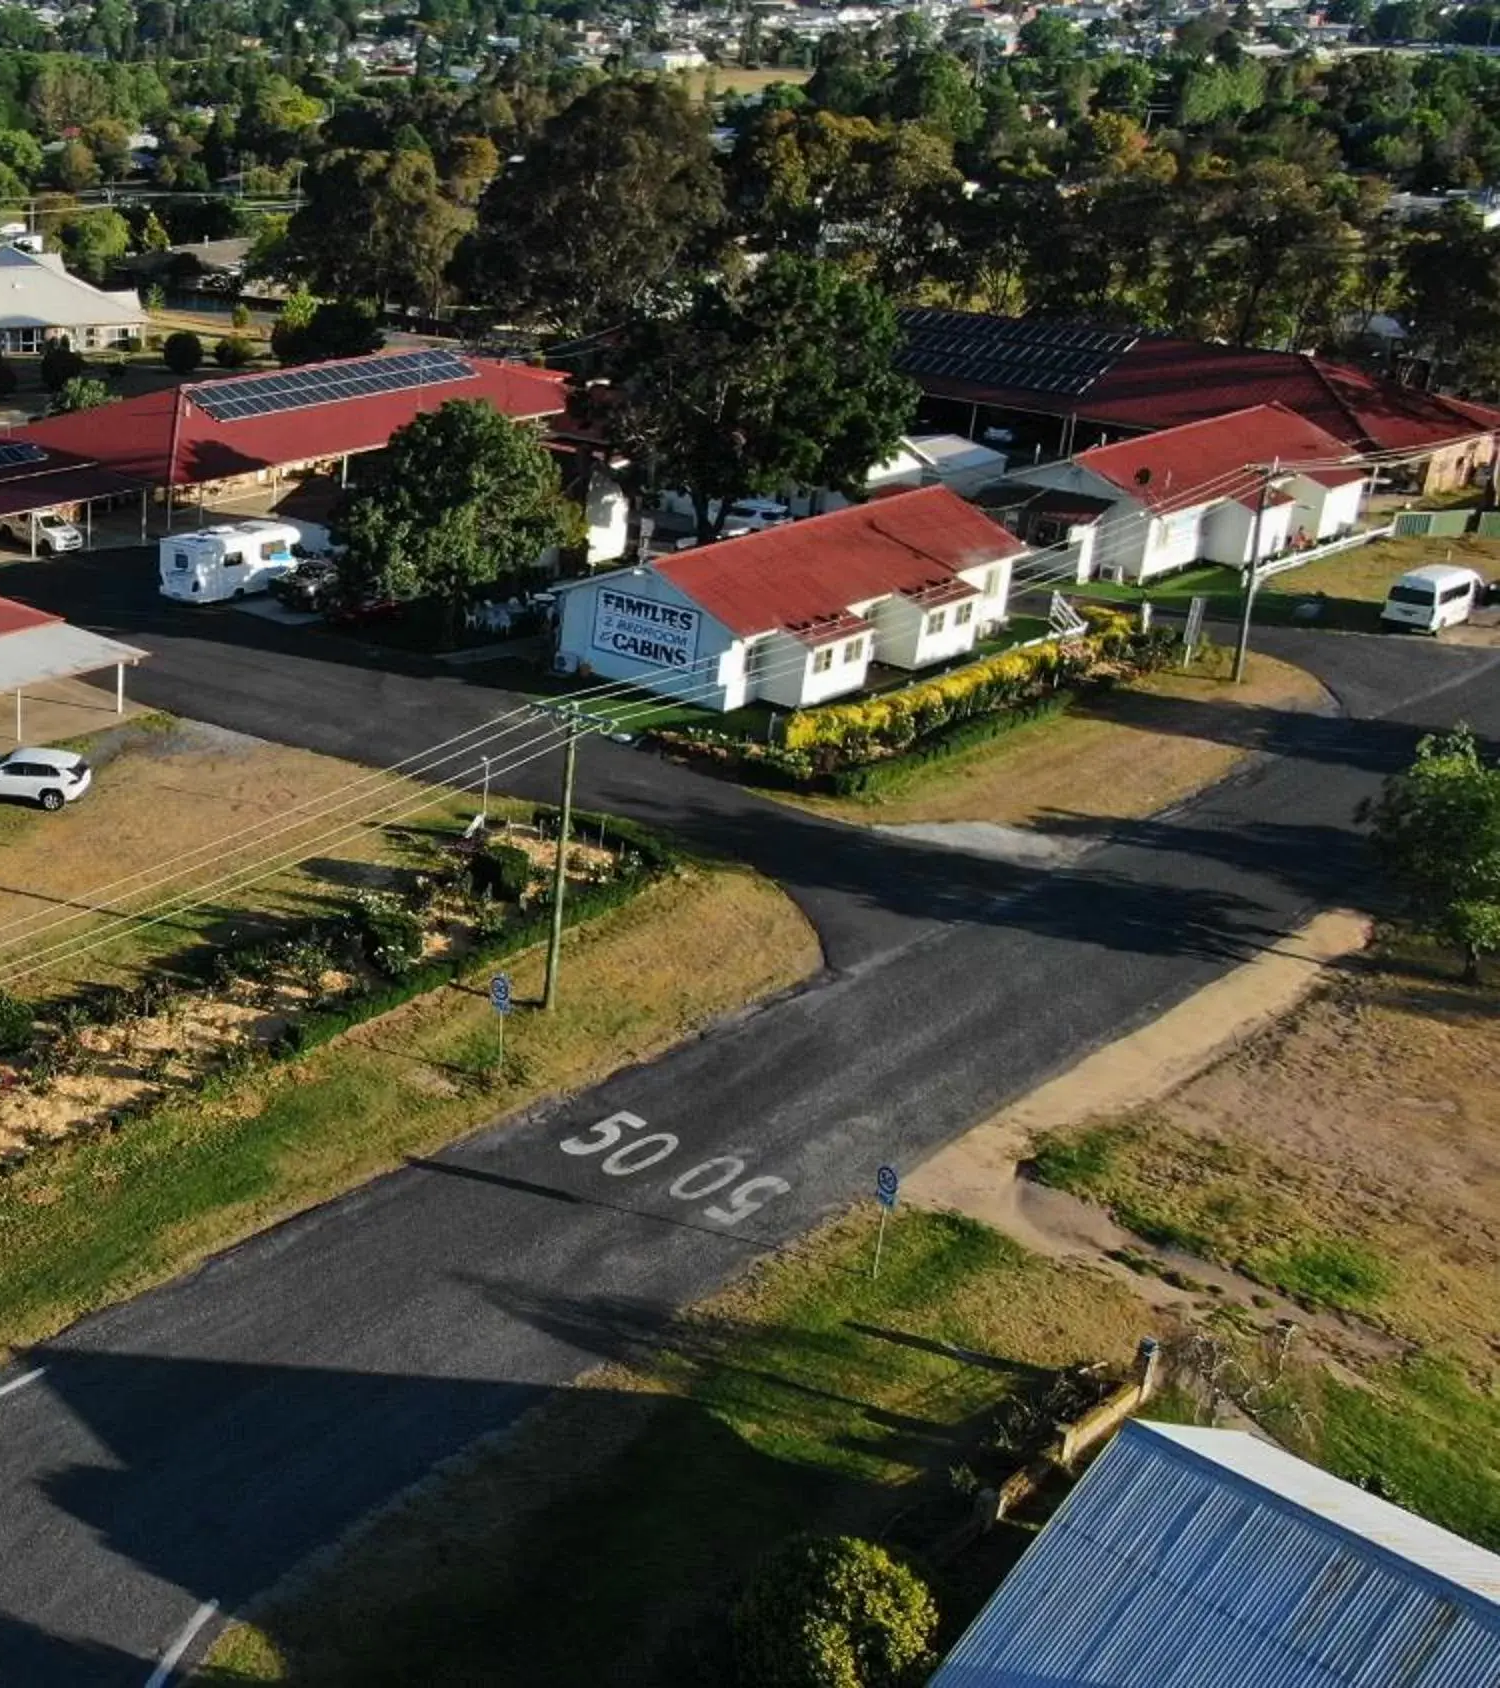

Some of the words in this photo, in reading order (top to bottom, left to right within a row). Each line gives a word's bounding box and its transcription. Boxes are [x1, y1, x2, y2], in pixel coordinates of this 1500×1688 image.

[602, 593, 693, 631] FAMILIES
[612, 633, 687, 667] CABINS
[616, 620, 688, 646] BEDROOM
[559, 1109, 680, 1177] 50
[669, 1155, 792, 1226] 50
